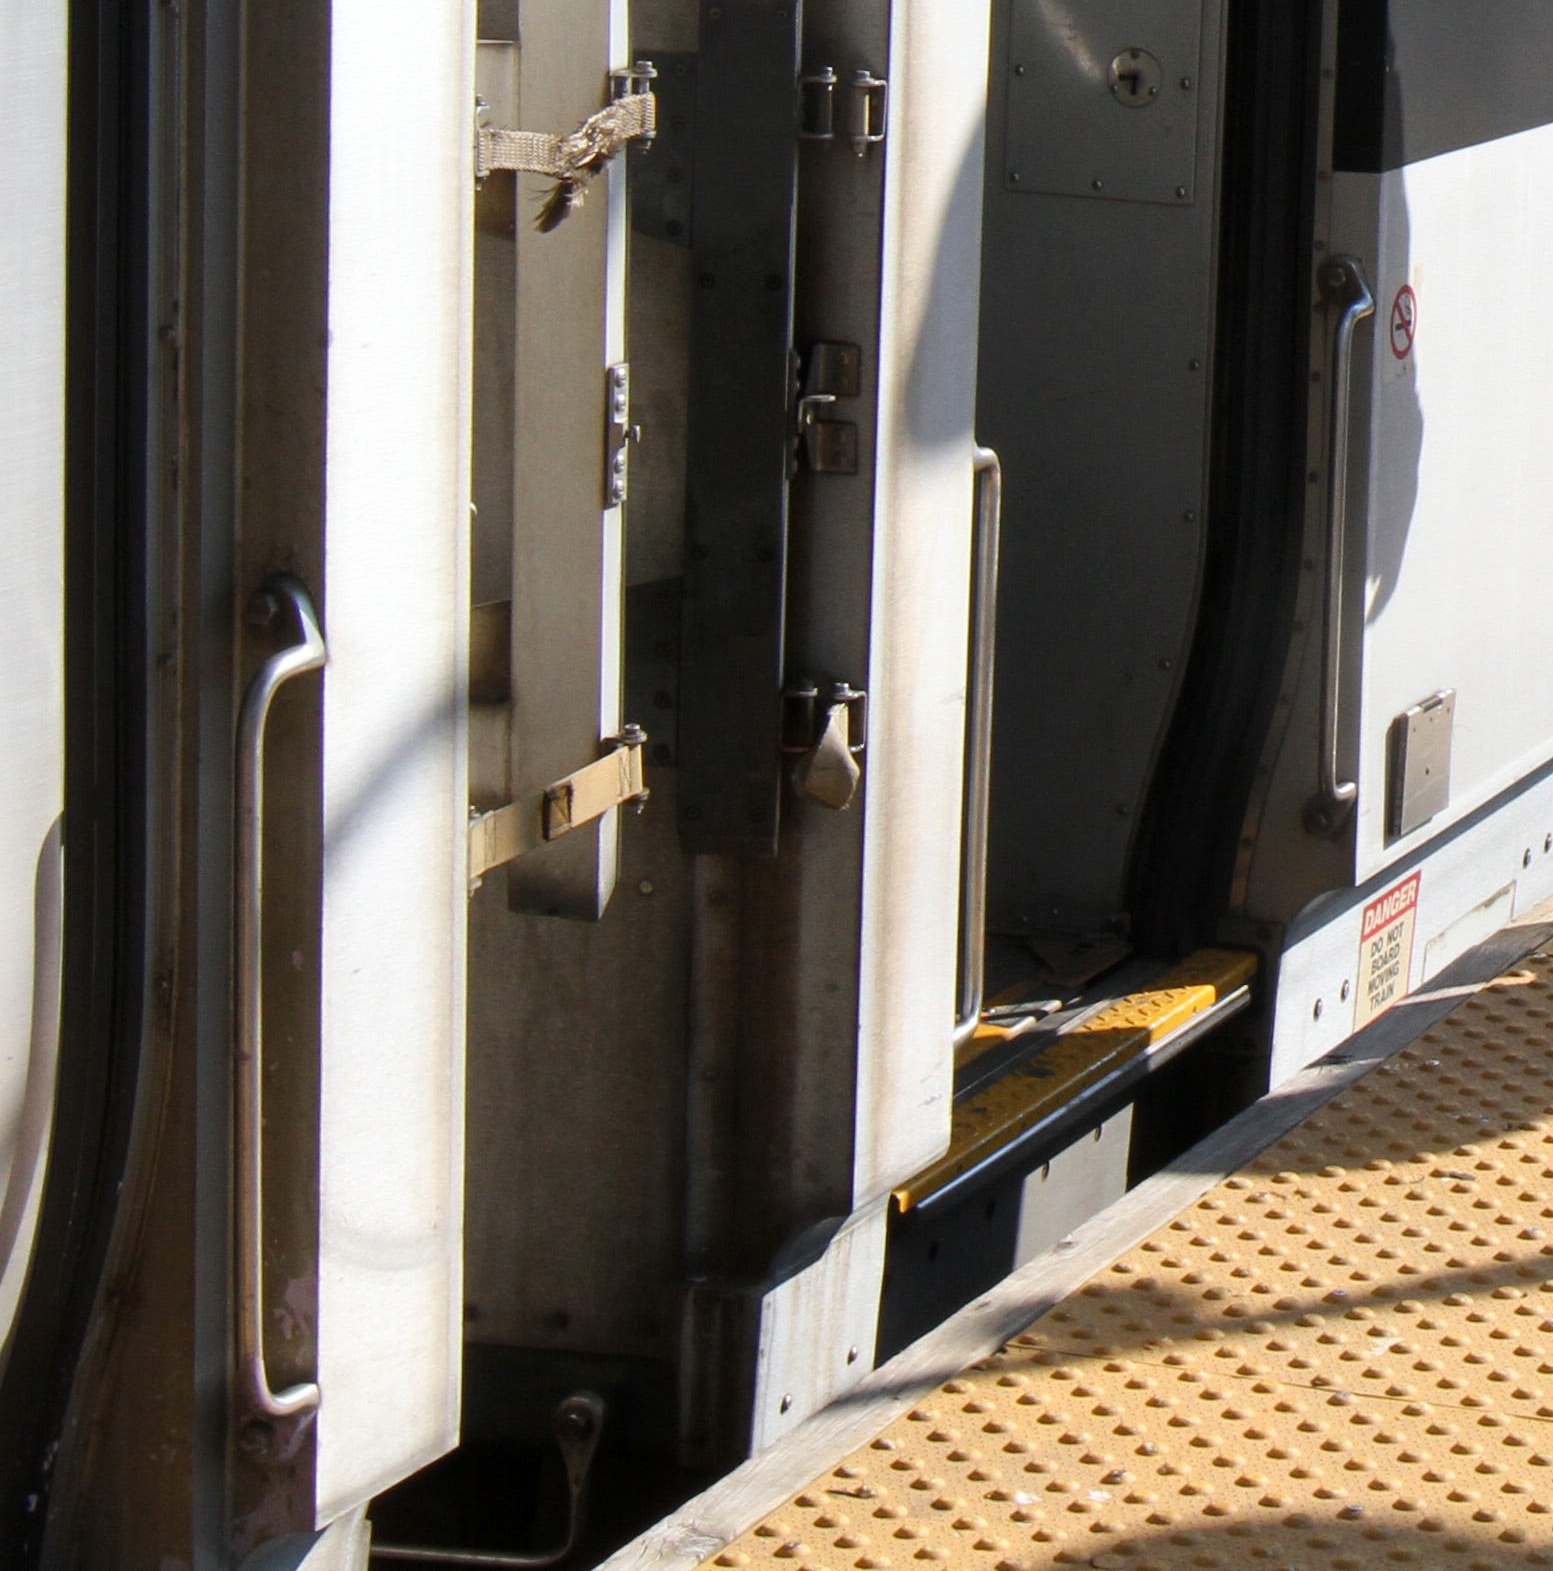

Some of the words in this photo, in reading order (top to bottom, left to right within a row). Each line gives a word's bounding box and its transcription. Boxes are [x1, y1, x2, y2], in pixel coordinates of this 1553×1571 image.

[1363, 878, 1417, 936] DANGER
[1370, 936, 1384, 958] DO
[1387, 922, 1404, 943] NOT
[1371, 943, 1400, 975] BOARD
[1368, 960, 1400, 996] MOVING
[1369, 983, 1395, 1012] TRAIN
